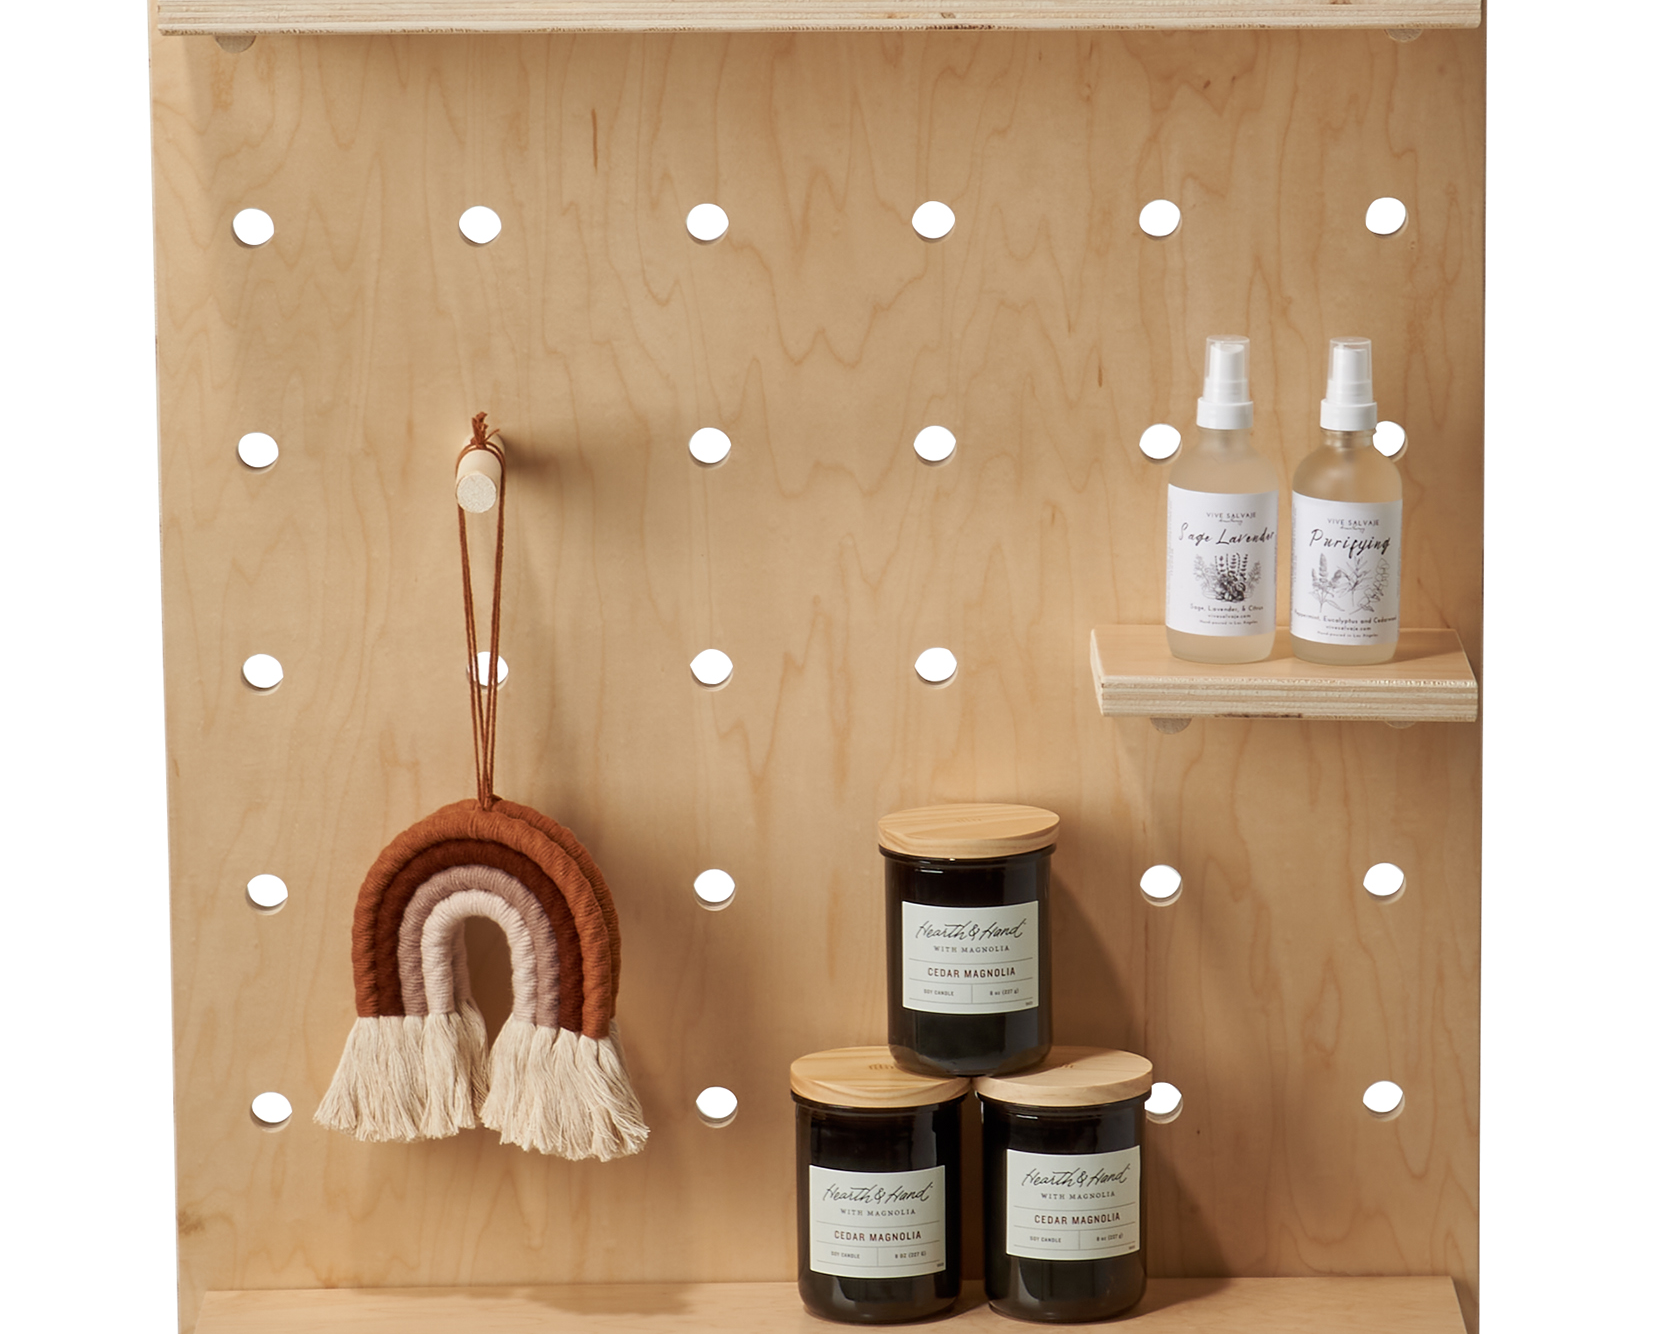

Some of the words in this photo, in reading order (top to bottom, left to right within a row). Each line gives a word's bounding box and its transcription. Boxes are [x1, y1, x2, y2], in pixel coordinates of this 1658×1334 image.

[1179, 522, 1212, 546] Sage
[1216, 527, 1275, 545] Lavender
[1309, 528, 1391, 559] Purifying
[1323, 615, 1359, 624] Eucalyptus
[915, 920, 972, 941] Hearth
[969, 923, 980, 941] &
[979, 918, 1027, 940] Hand
[933, 945, 958, 953] WITH
[961, 945, 1010, 954] MAGNOLIA
[927, 967, 960, 978] CEDAR
[964, 967, 1016, 979] MAGNOLIA
[934, 989, 954, 997] CANDLE
[1021, 1168, 1080, 1187] Hearth
[1076, 1171, 1088, 1187] &
[1086, 1163, 1131, 1187] Hand
[822, 1183, 878, 1204] Hearth
[874, 1188, 886, 1204] &
[884, 1182, 934, 1204] Hand
[1041, 1192, 1065, 1200] WITH
[1069, 1191, 1116, 1200] MAGNOLIA
[840, 1208, 863, 1216] WITH
[867, 1208, 916, 1217] MAGNOLIA
[1034, 1214, 1068, 1225] CEDAR
[1072, 1212, 1121, 1225] MAGNOLIA
[834, 1230, 865, 1241] CEDAR
[869, 1231, 922, 1242] MAGNOLIA
